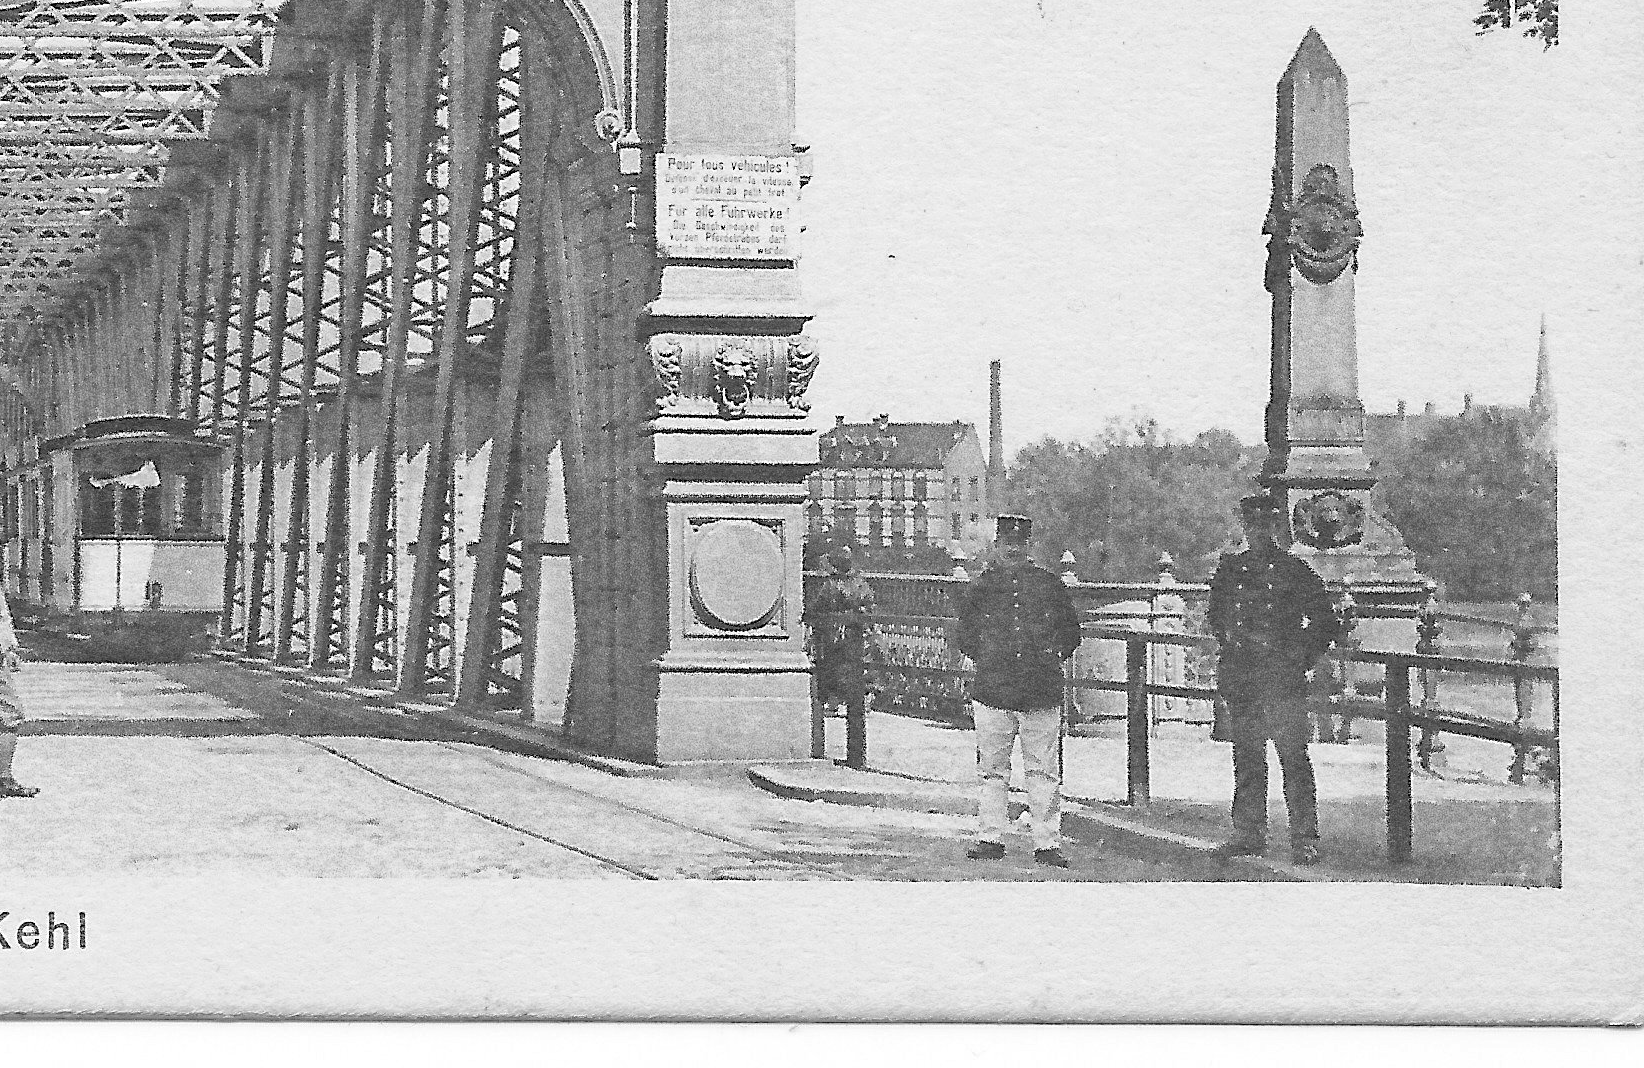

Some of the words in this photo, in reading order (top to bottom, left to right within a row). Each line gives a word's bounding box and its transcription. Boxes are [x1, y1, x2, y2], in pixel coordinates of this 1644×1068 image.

[667, 157, 696, 171] Pour
[701, 158, 725, 171] tous
[695, 204, 715, 218] alle
